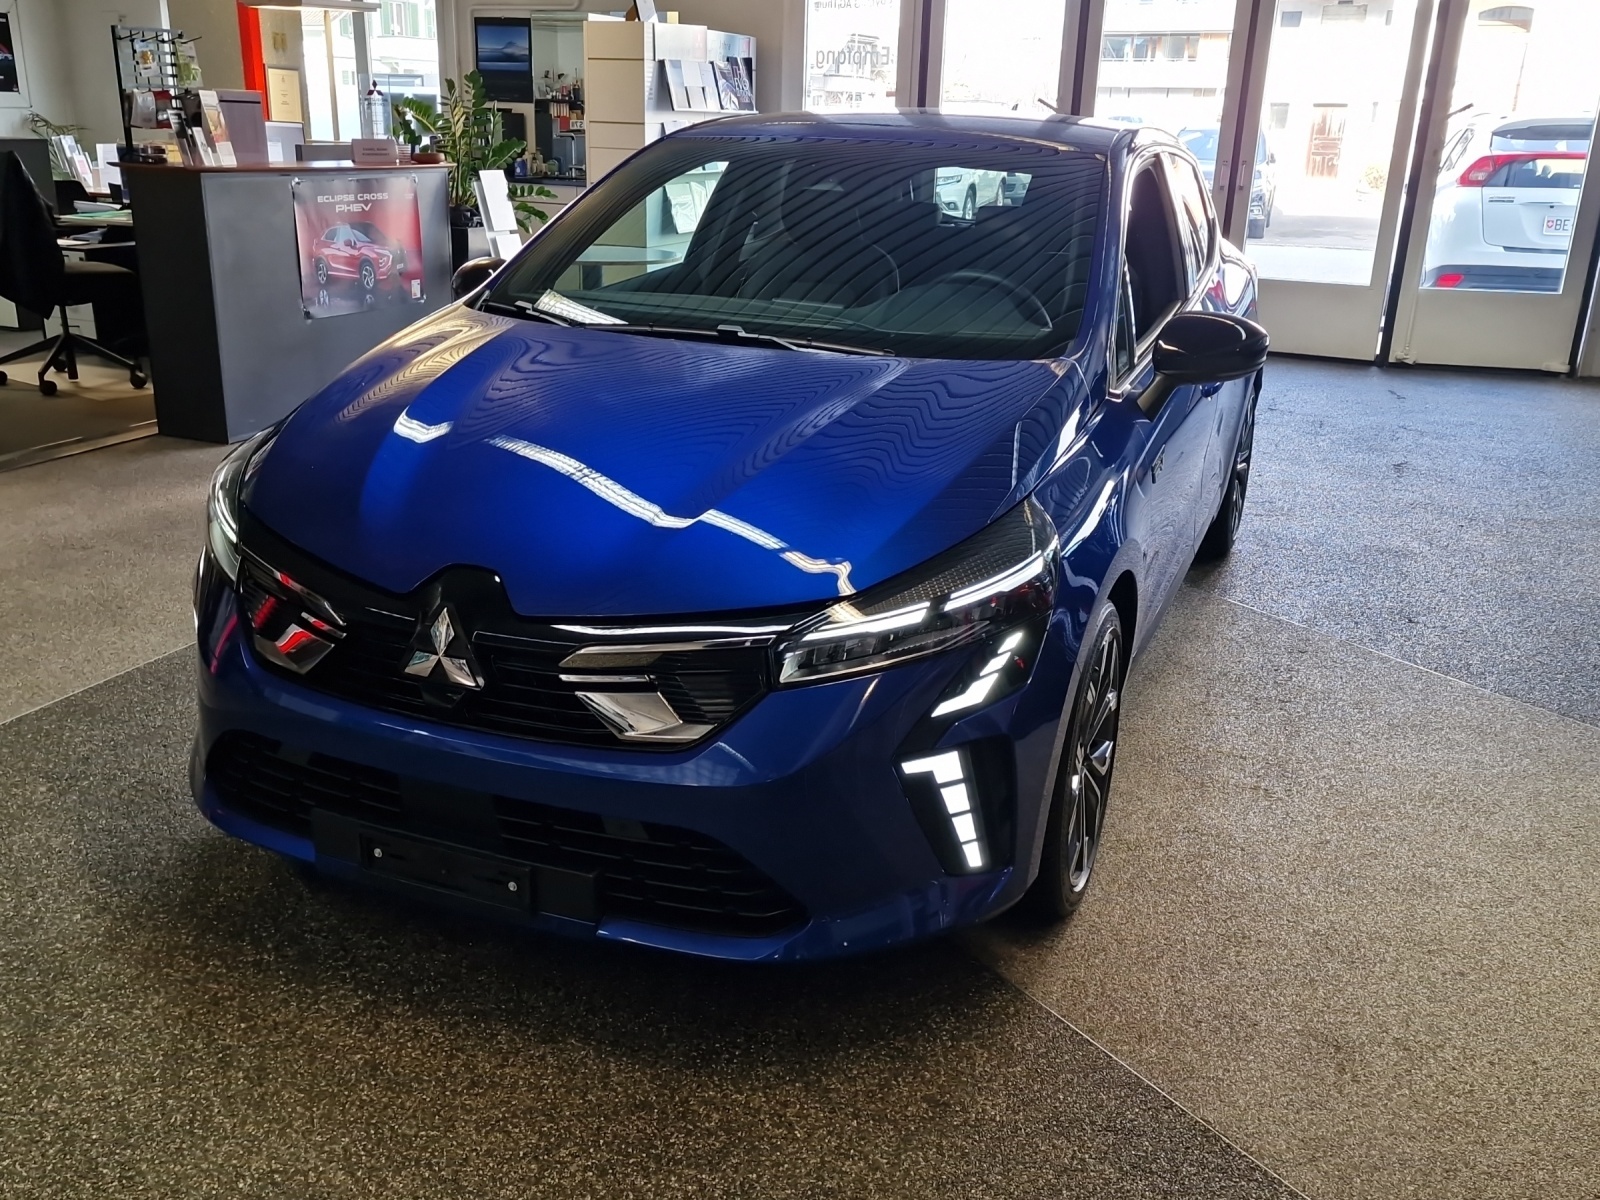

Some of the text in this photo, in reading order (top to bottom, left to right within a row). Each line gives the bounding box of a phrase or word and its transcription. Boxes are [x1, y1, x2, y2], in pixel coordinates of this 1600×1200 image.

[317, 192, 389, 203] ECLIPSE CROSS
[335, 203, 372, 213] PHEV
[1554, 218, 1570, 231] BE
